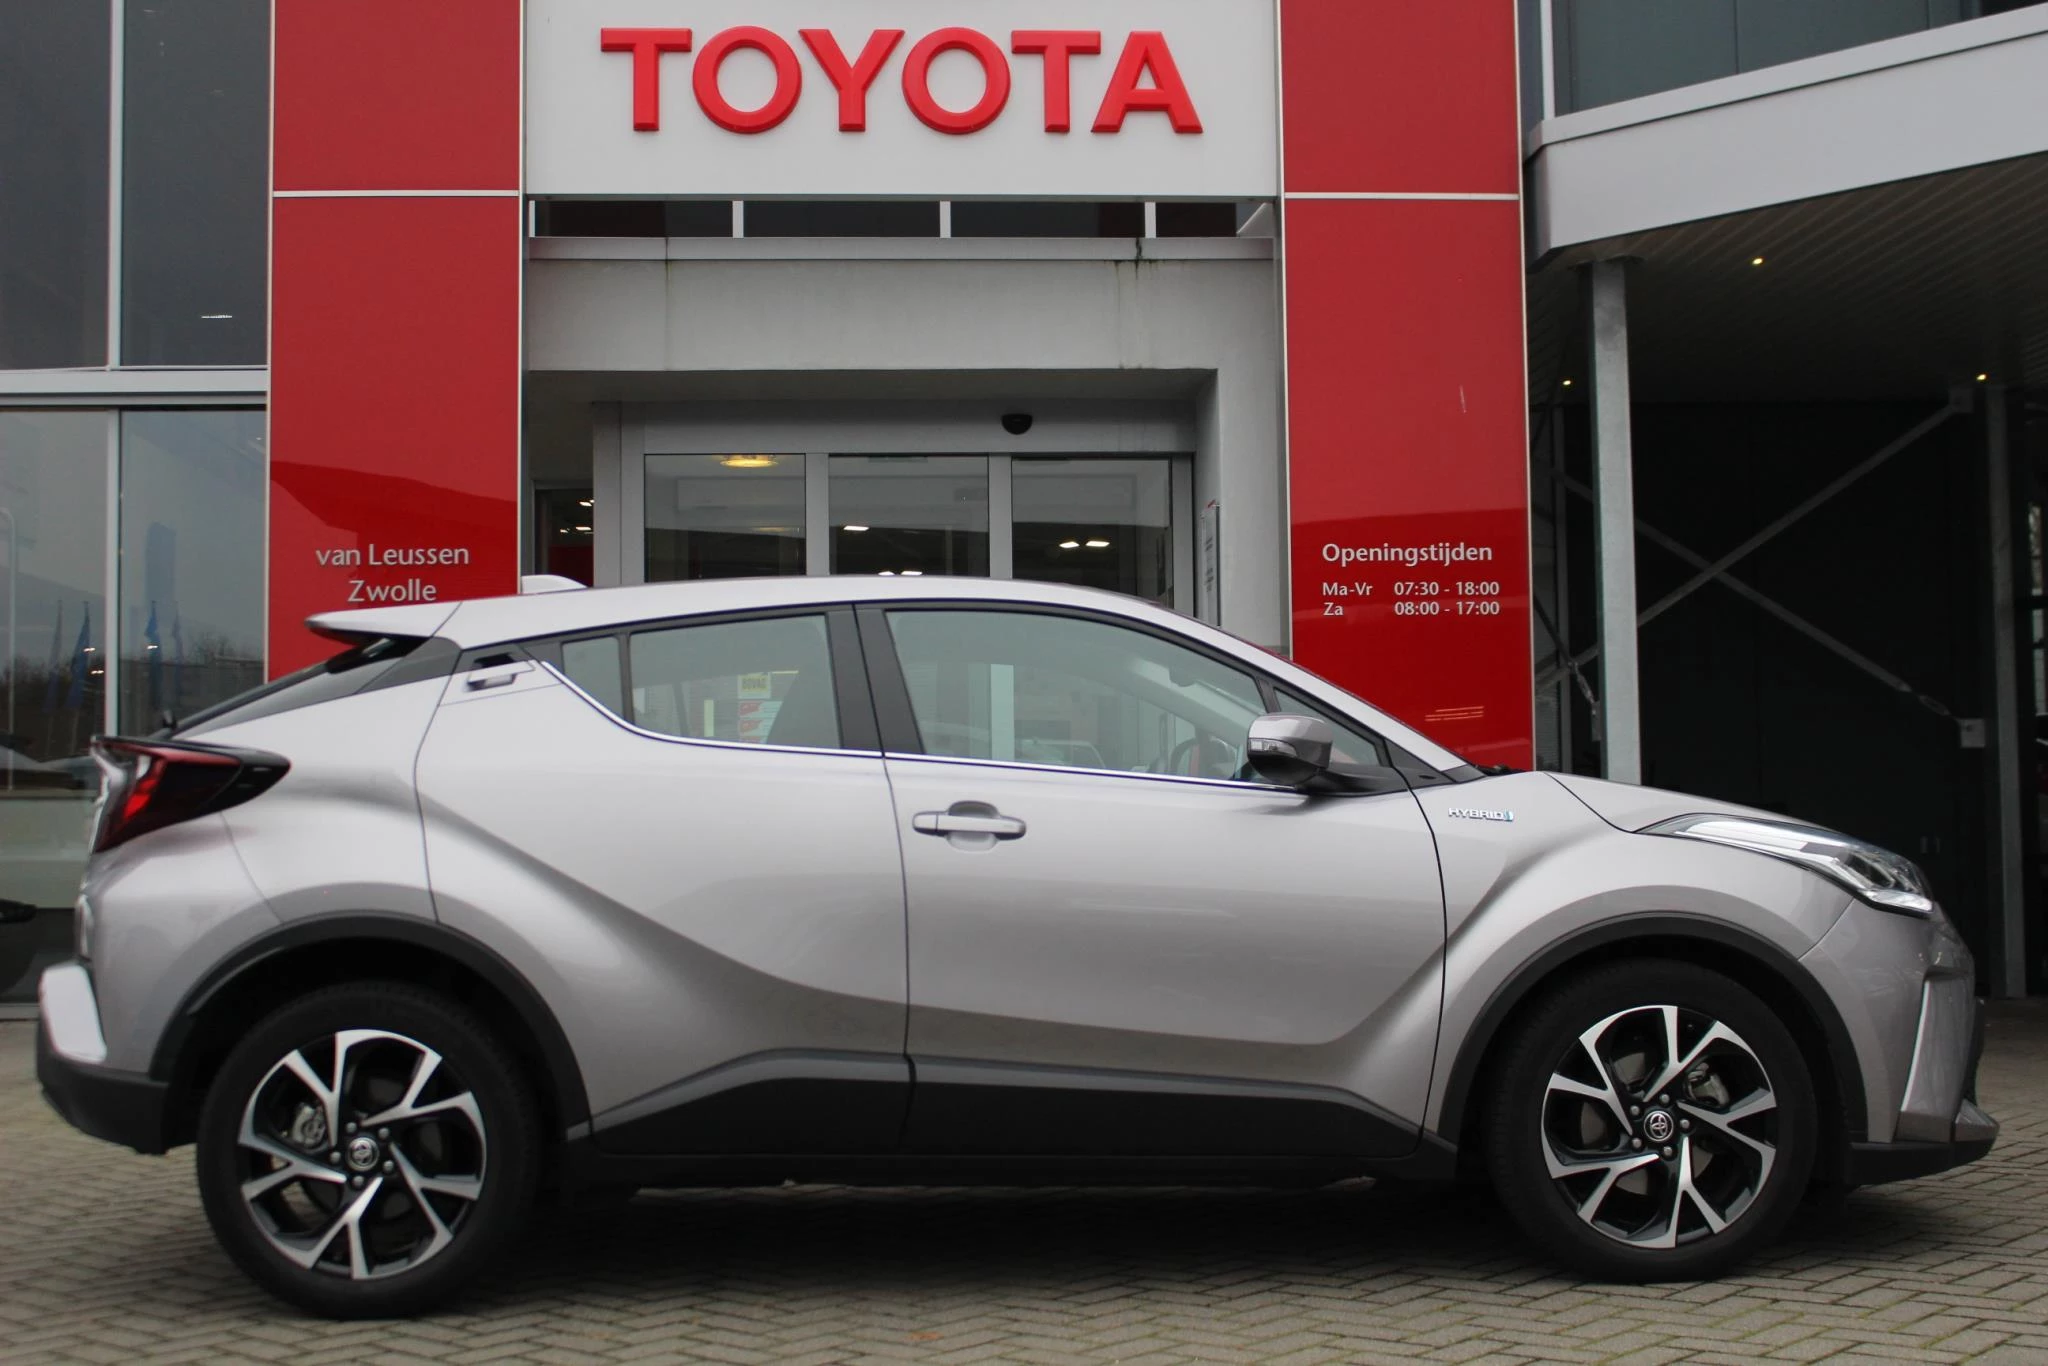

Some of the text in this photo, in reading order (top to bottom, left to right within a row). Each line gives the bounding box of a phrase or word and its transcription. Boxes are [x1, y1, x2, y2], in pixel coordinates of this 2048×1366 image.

[600, 25, 1203, 134] TOYOTA
[315, 543, 470, 566] van Leussen
[1322, 542, 1493, 567] Openingstijden
[347, 578, 437, 602] Zwolle
[1322, 582, 1373, 596] Ma-Vr
[1394, 581, 1439, 596] 07:30
[1456, 581, 1500, 596] 18:00
[1323, 602, 1344, 616] Za
[1394, 601, 1440, 616] 08:00
[1456, 601, 1500, 616] 17:00
[1448, 807, 1504, 820] HYBRID
